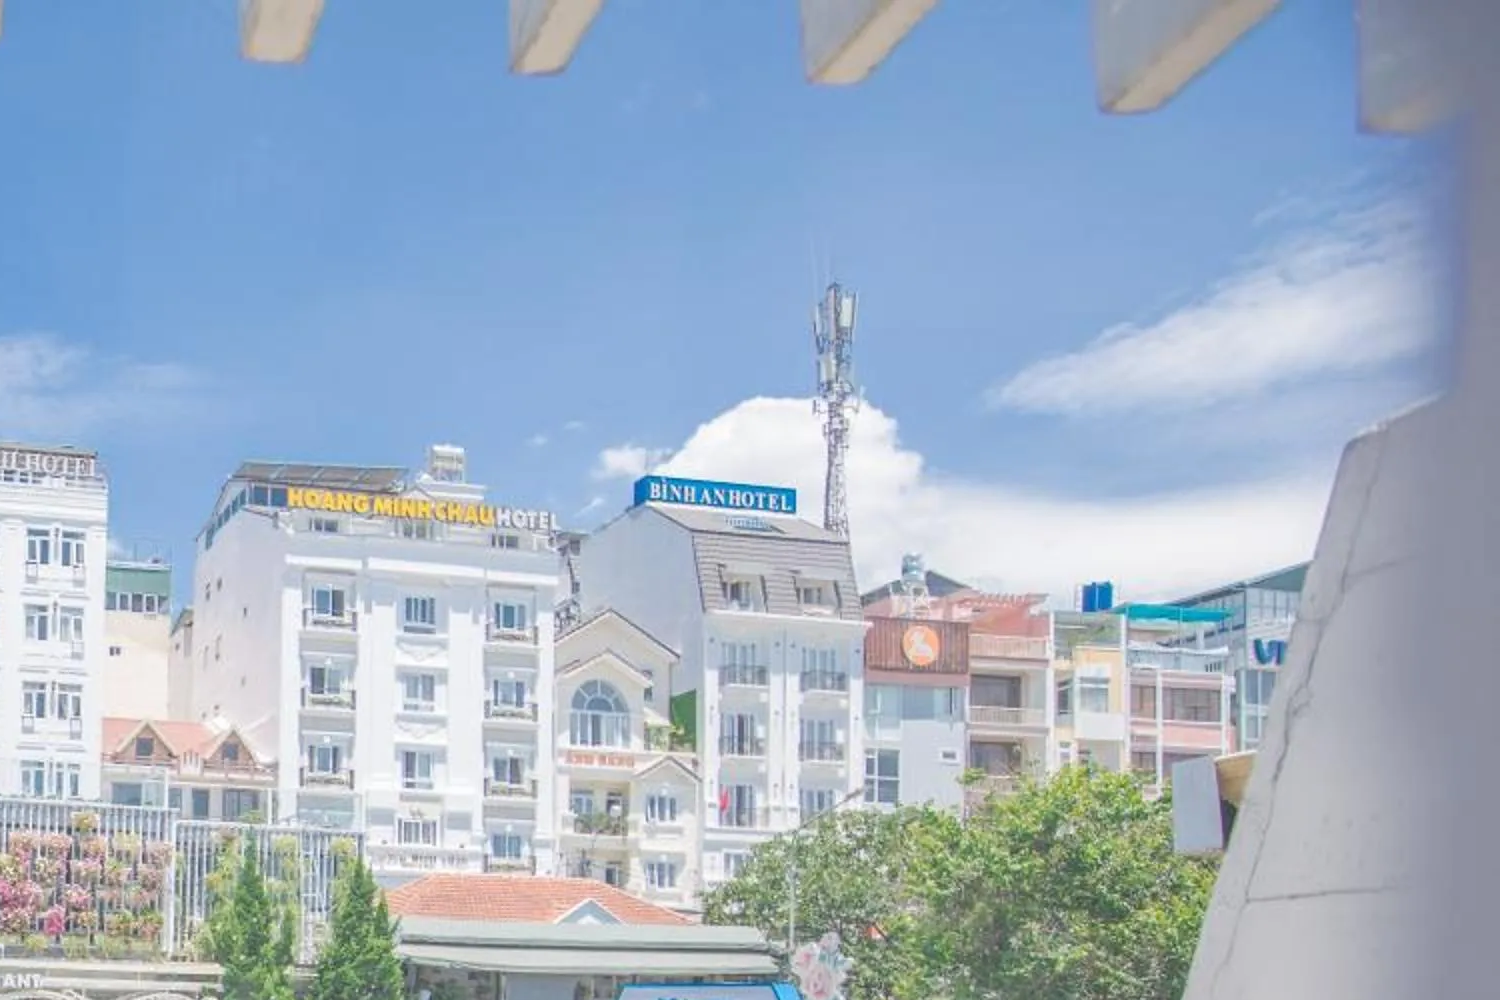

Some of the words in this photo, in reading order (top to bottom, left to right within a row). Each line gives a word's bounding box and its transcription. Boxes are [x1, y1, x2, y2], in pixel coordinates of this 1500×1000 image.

[287, 486, 369, 513] HOANG
[373, 496, 431, 519] MINH
[435, 502, 494, 526] CHAU
[495, 507, 560, 530] HOTEL
[650, 478, 696, 503] BÌNH
[700, 488, 725, 505] AN
[728, 490, 792, 511] HOTEL
